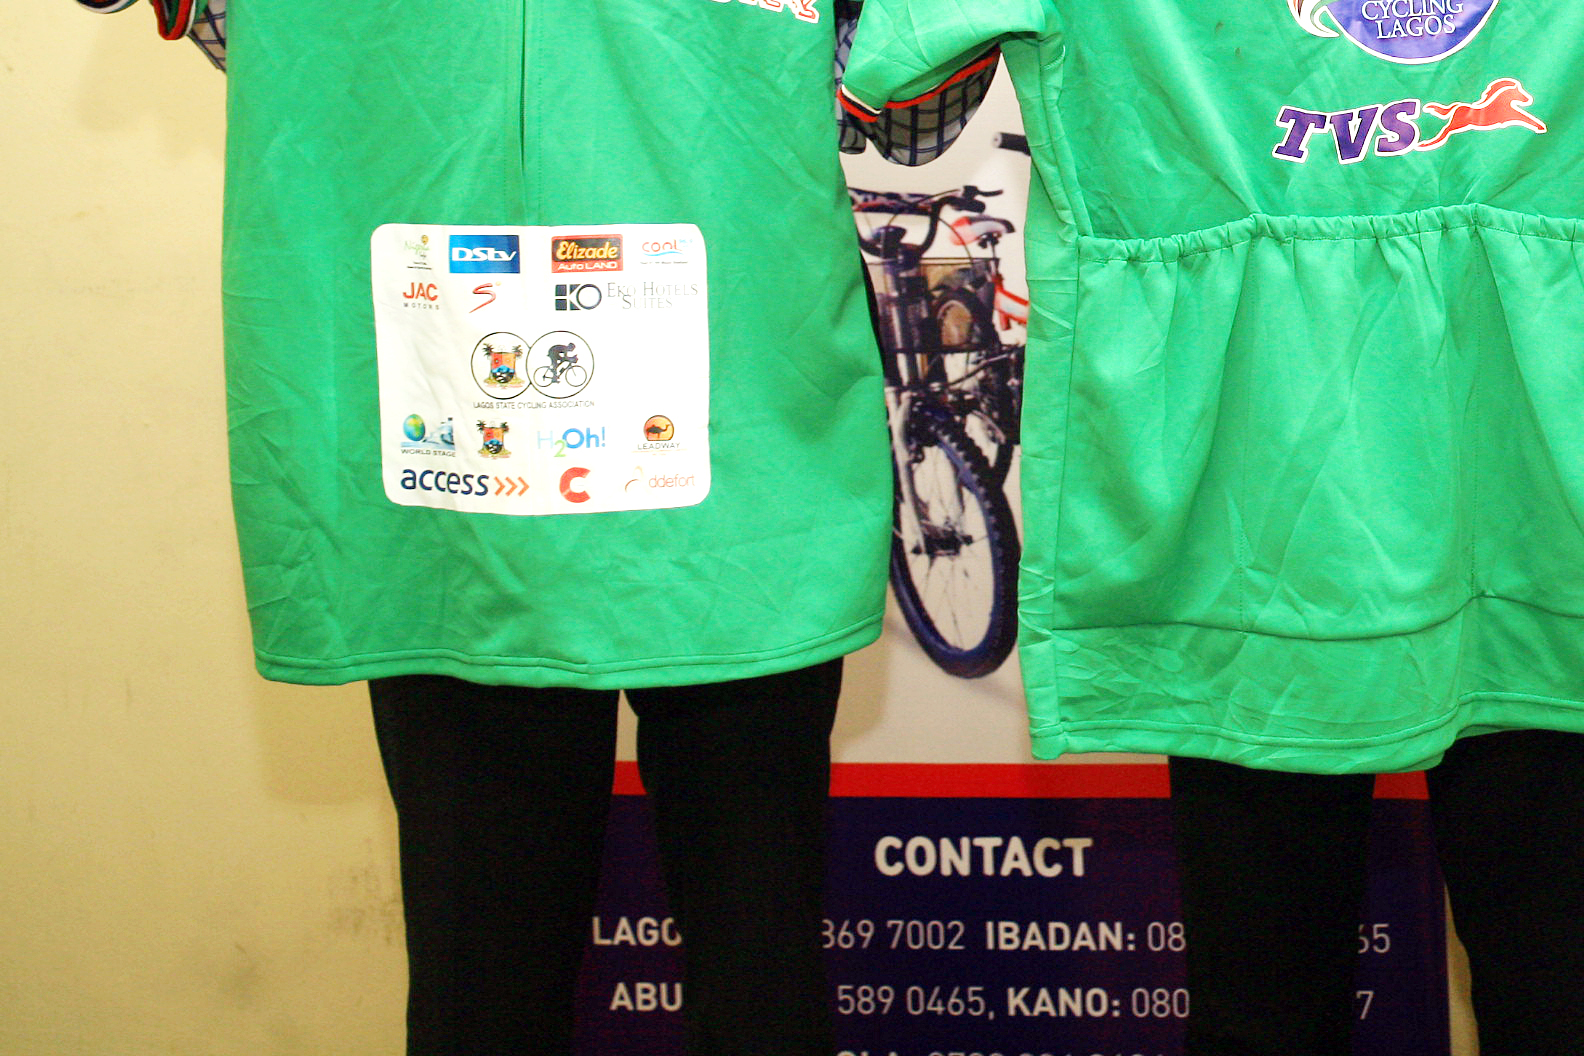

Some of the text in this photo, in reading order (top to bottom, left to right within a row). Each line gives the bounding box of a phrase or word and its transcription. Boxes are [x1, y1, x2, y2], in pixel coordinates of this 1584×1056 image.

[1375, 13, 1457, 40] LAGOS
[1272, 99, 1419, 162] TVS
[556, 240, 619, 261] Elizade
[557, 261, 617, 271] Auto LAND
[402, 282, 439, 301] JAC
[622, 294, 673, 310] SUITES
[473, 400, 595, 410] LAGOS STATE CYCLING ASSOCIATION
[432, 450, 456, 458] STAGE
[637, 442, 681, 451] LEADWAY
[400, 468, 490, 497] access
[873, 835, 1094, 877] CONTACT
[885, 919, 966, 950] 7002
[985, 920, 1136, 952] IBADAN:
[836, 984, 895, 1015] 589
[906, 985, 996, 1021] 0465,
[1006, 986, 1121, 1018] KANO:
